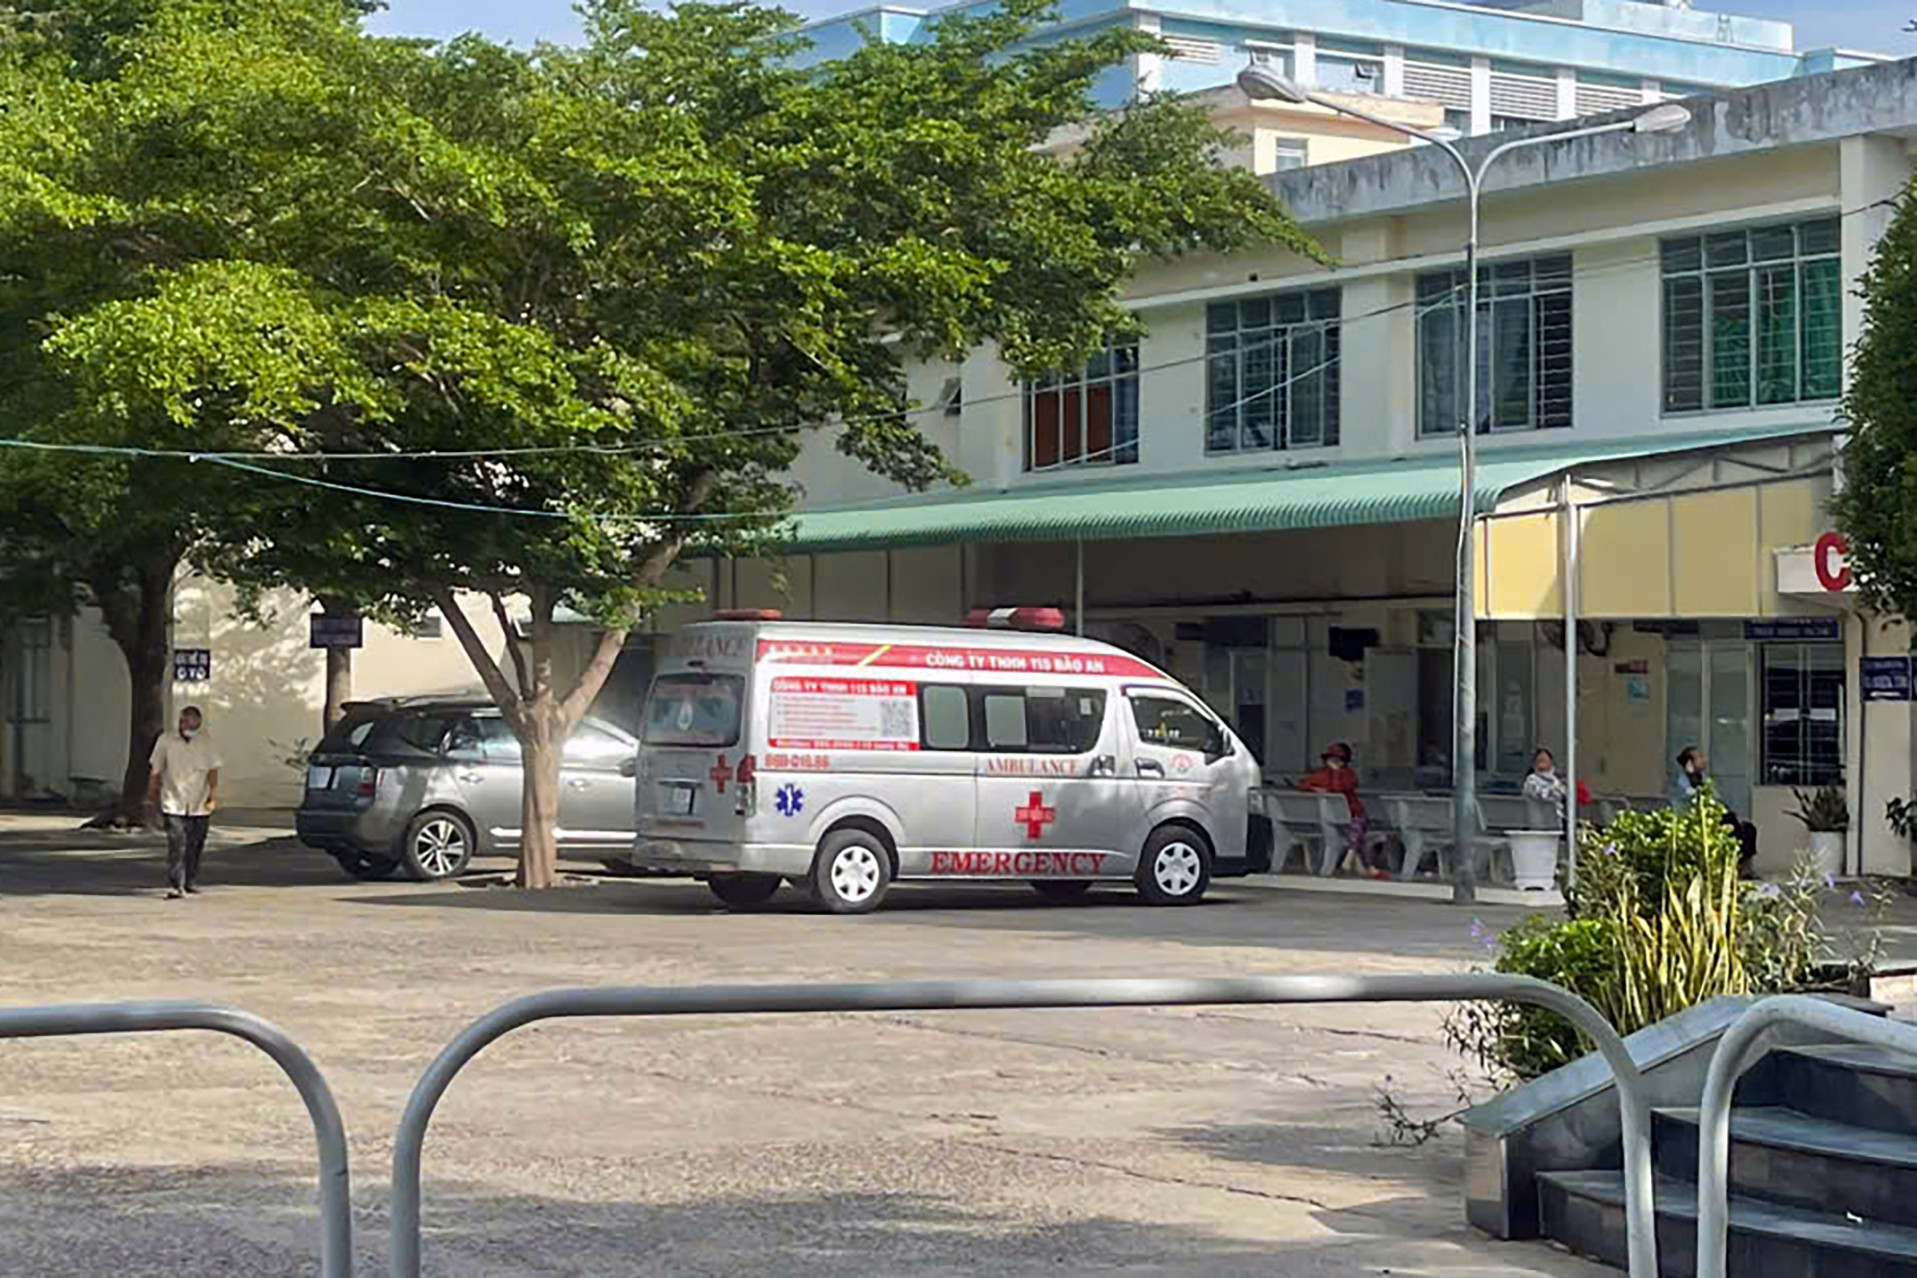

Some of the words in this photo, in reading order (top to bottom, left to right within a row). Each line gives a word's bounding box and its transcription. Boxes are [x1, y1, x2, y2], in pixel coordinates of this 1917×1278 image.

[968, 654, 985, 669] TY
[989, 655, 1026, 670] TNHH
[1086, 658, 1105, 673] AN
[986, 757, 1080, 775] AMBULANCE
[930, 850, 1107, 876] EMERGENCY
